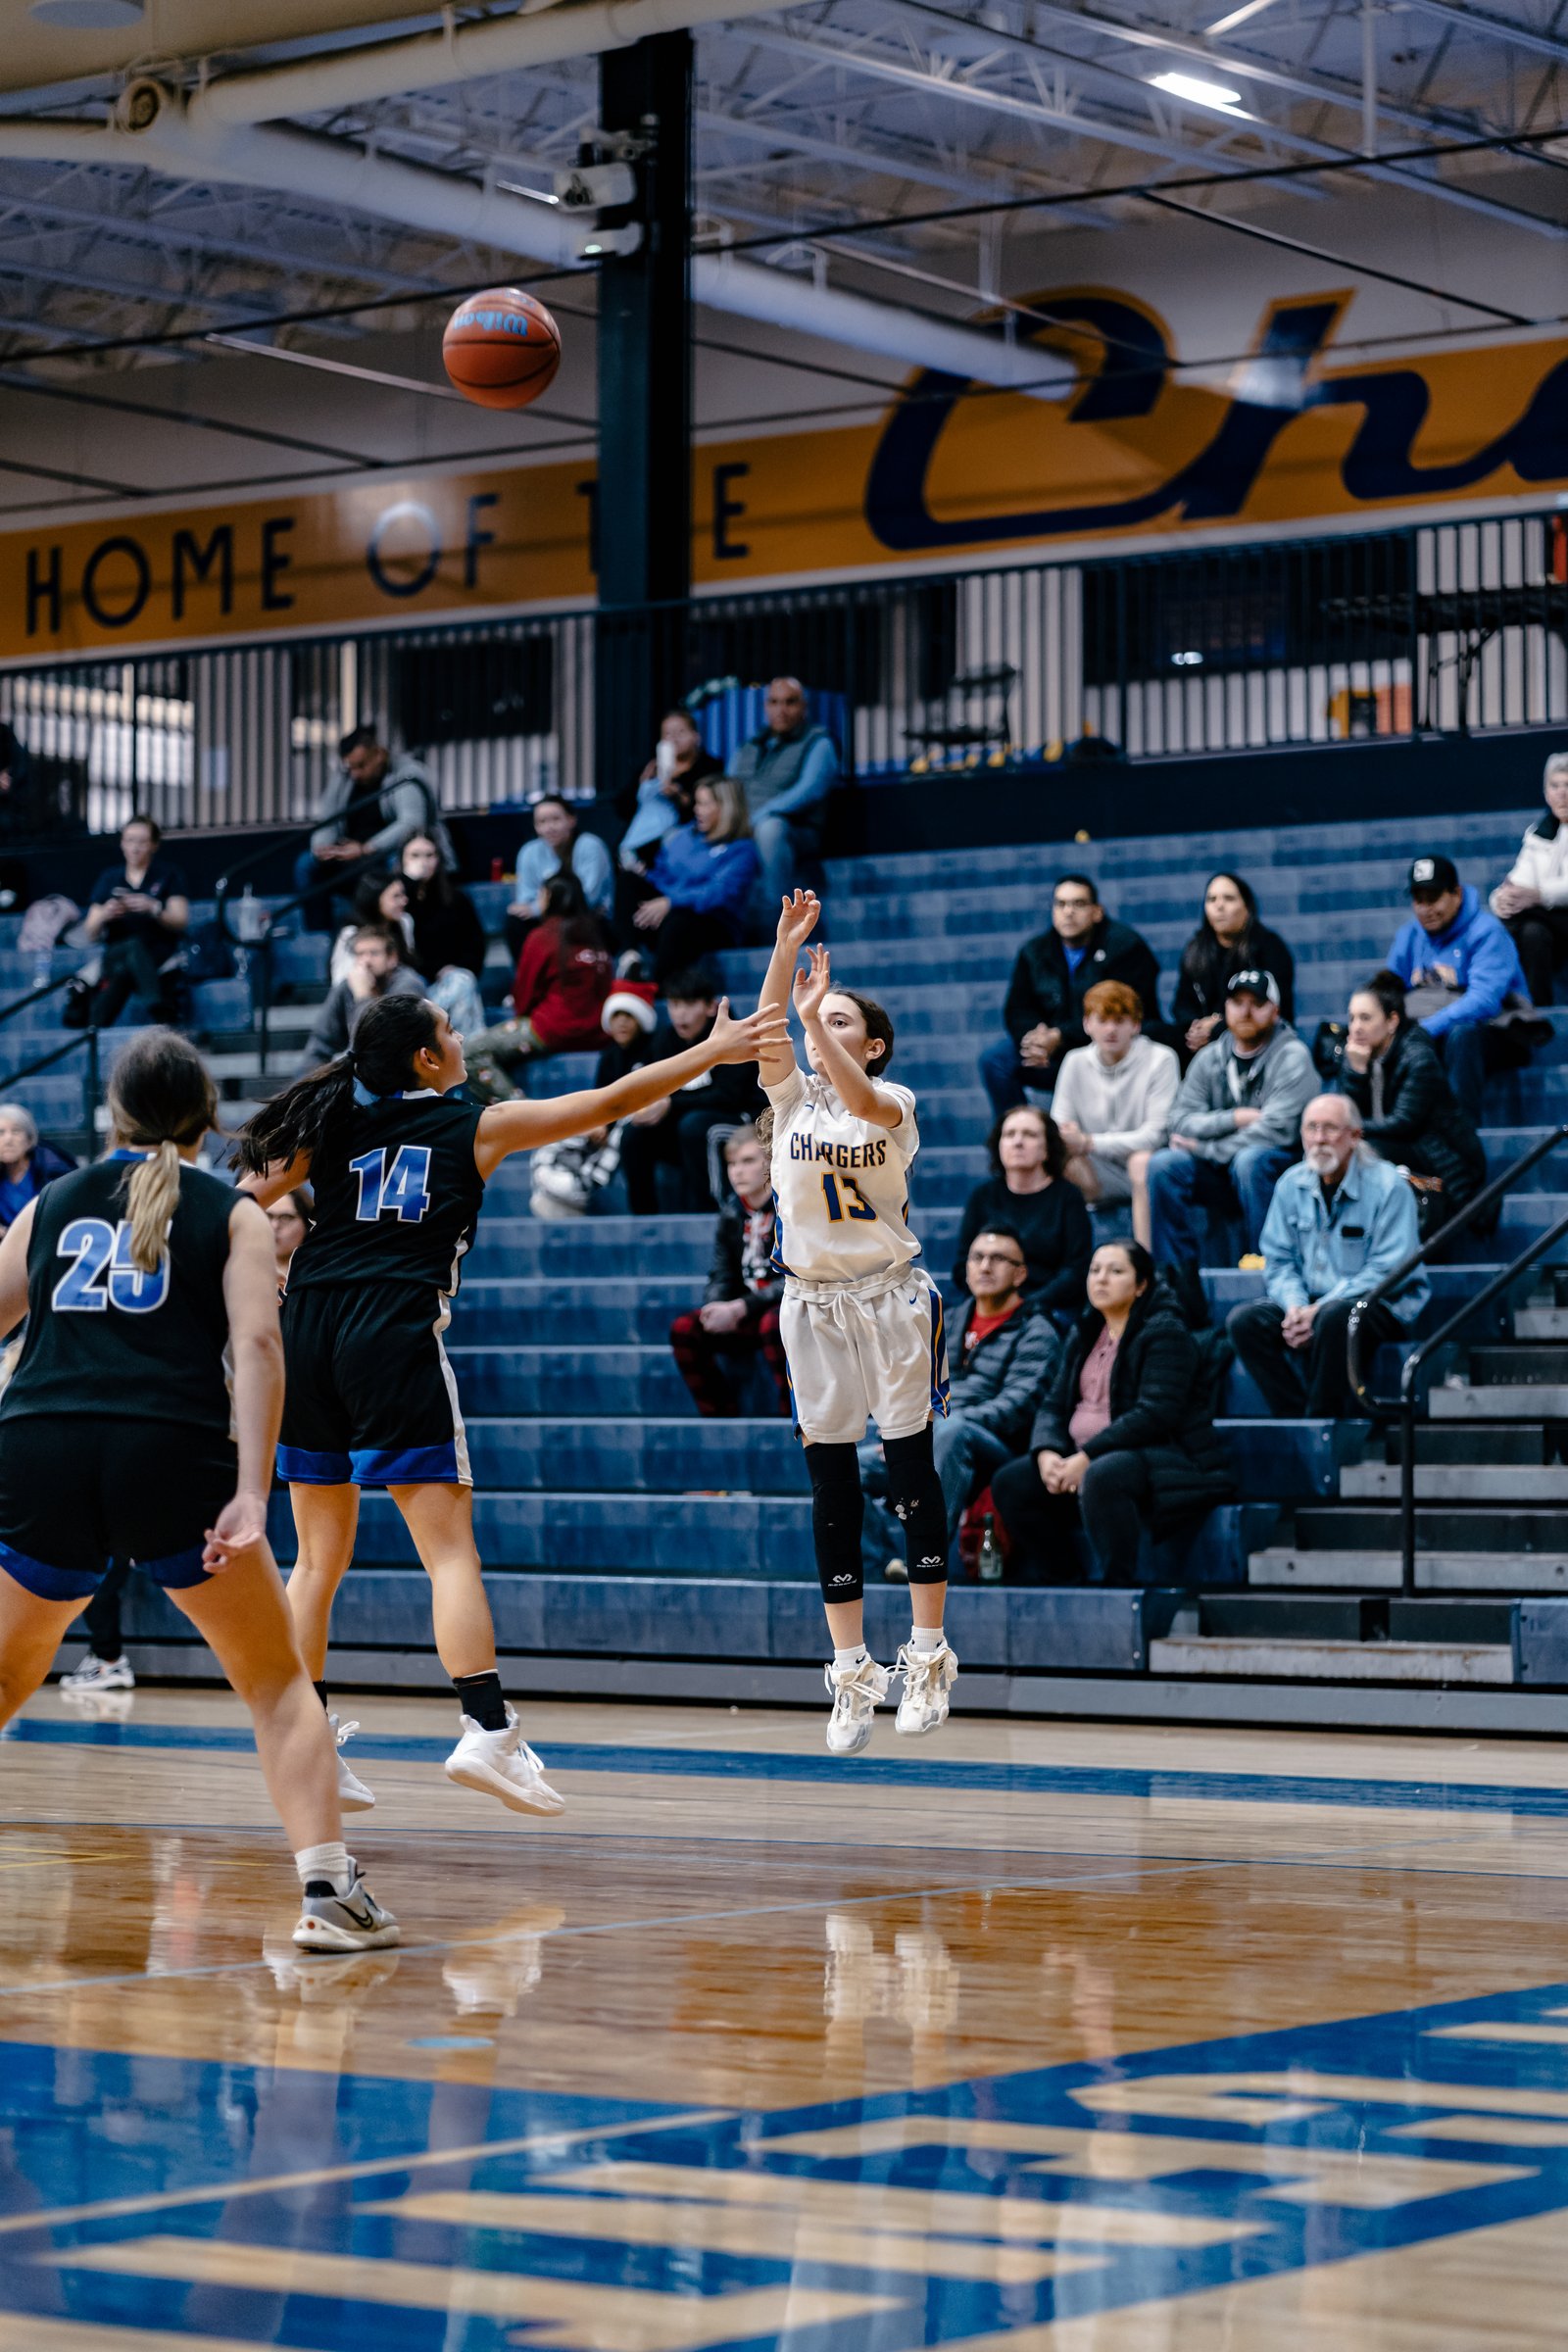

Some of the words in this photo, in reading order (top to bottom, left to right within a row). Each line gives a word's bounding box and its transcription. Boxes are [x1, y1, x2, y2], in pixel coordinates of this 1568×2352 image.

[25, 518, 295, 636] HOME
[366, 493, 499, 598] OF
[576, 463, 750, 574] TE
[349, 1145, 432, 1223] 14
[820, 1171, 879, 1224] 13
[51, 1216, 172, 1314] 25
